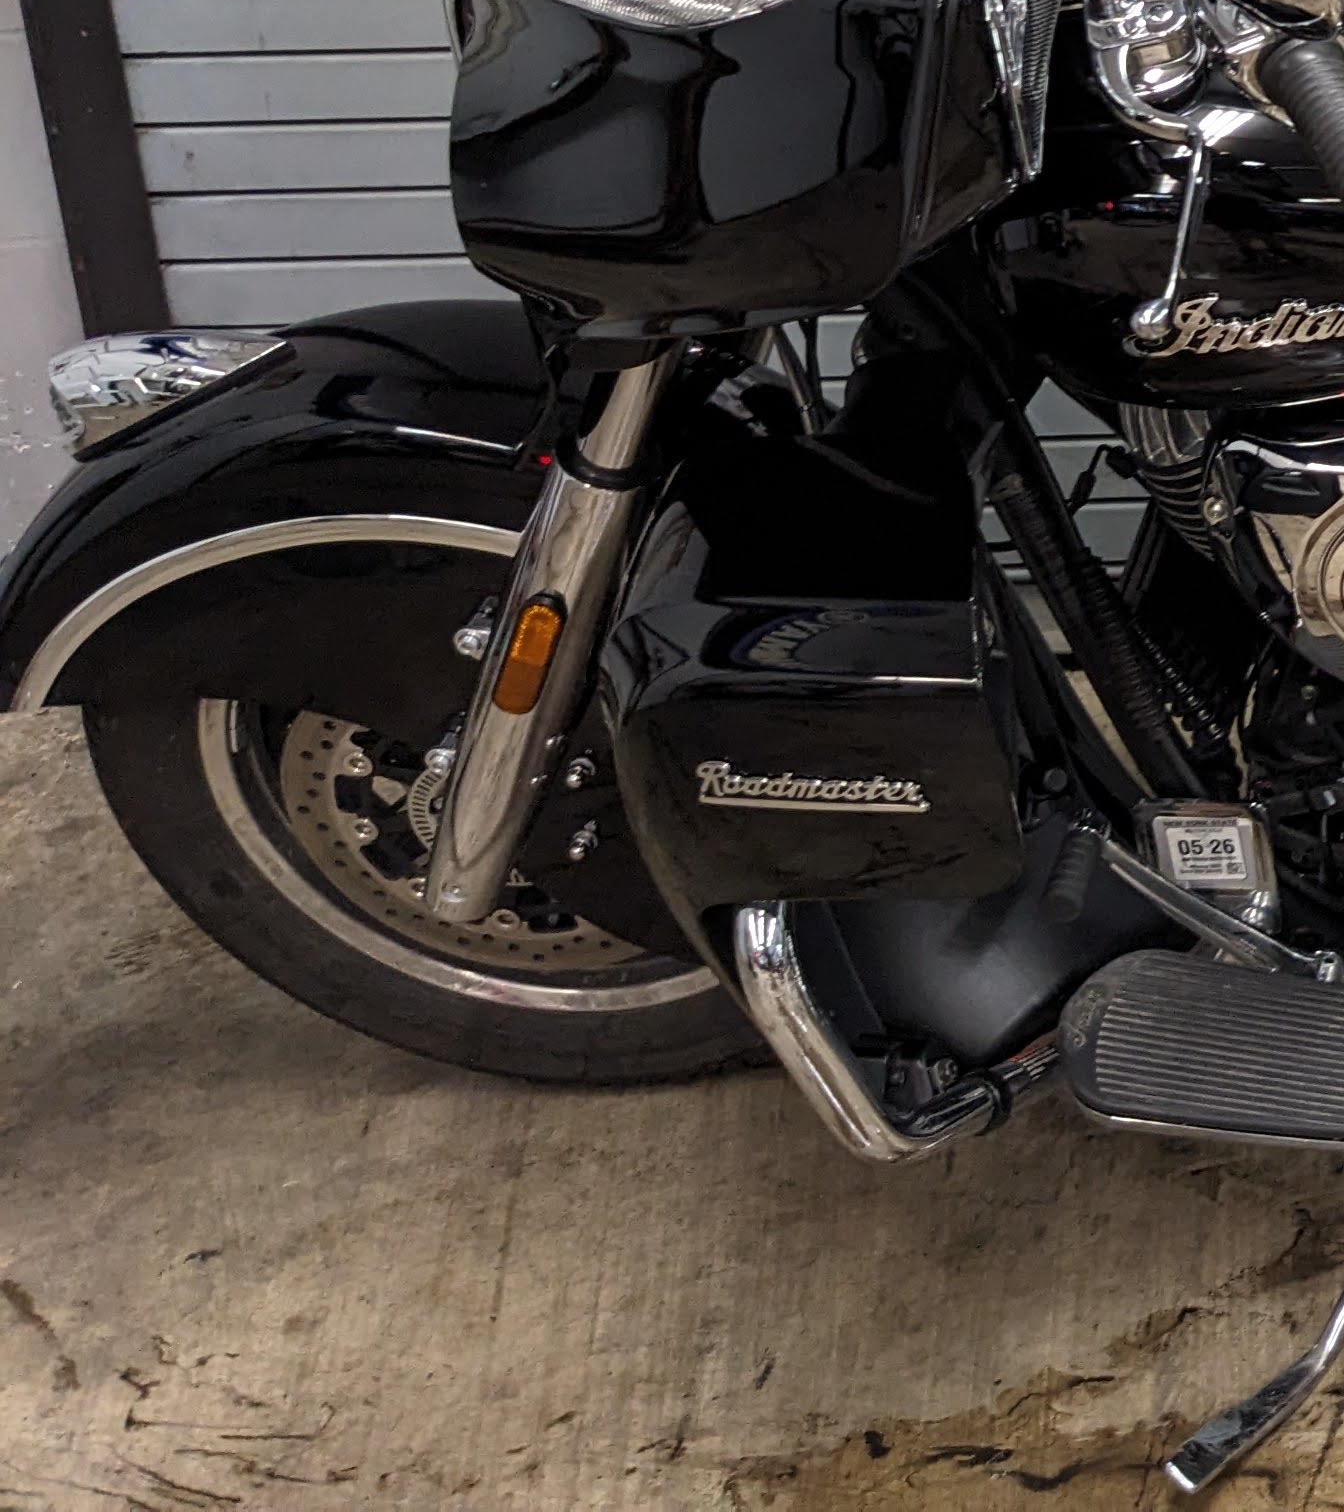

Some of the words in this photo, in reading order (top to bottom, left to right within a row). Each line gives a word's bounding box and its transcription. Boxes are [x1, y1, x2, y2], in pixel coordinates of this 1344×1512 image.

[695, 760, 926, 804] Roadmaster
[1177, 839, 1204, 855] 05
[1209, 838, 1235, 854] 26
